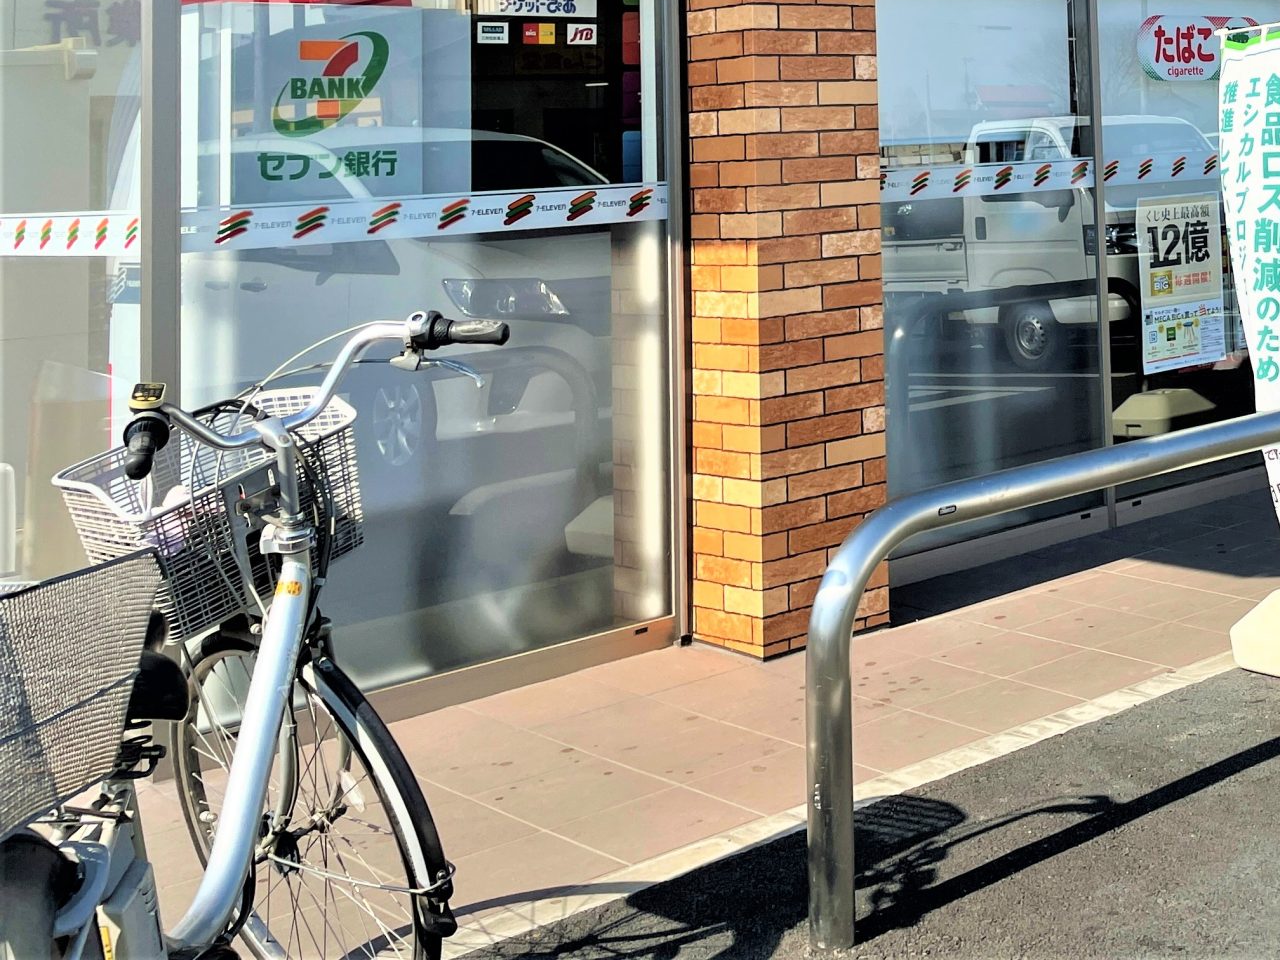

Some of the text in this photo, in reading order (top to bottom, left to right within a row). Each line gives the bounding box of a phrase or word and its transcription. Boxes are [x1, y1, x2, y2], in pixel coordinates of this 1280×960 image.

[1153, 24, 1215, 64] たばこ
[1167, 66, 1204, 77] cigarette
[290, 77, 366, 100] BANK
[257, 149, 398, 181] セブン銀行
[471, 208, 504, 216] 7-ELEVEN
[535, 203, 566, 212] 7-ELEVEN
[1146, 204, 1210, 223] くじ史上最高額
[1147, 220, 1210, 269] 12億
